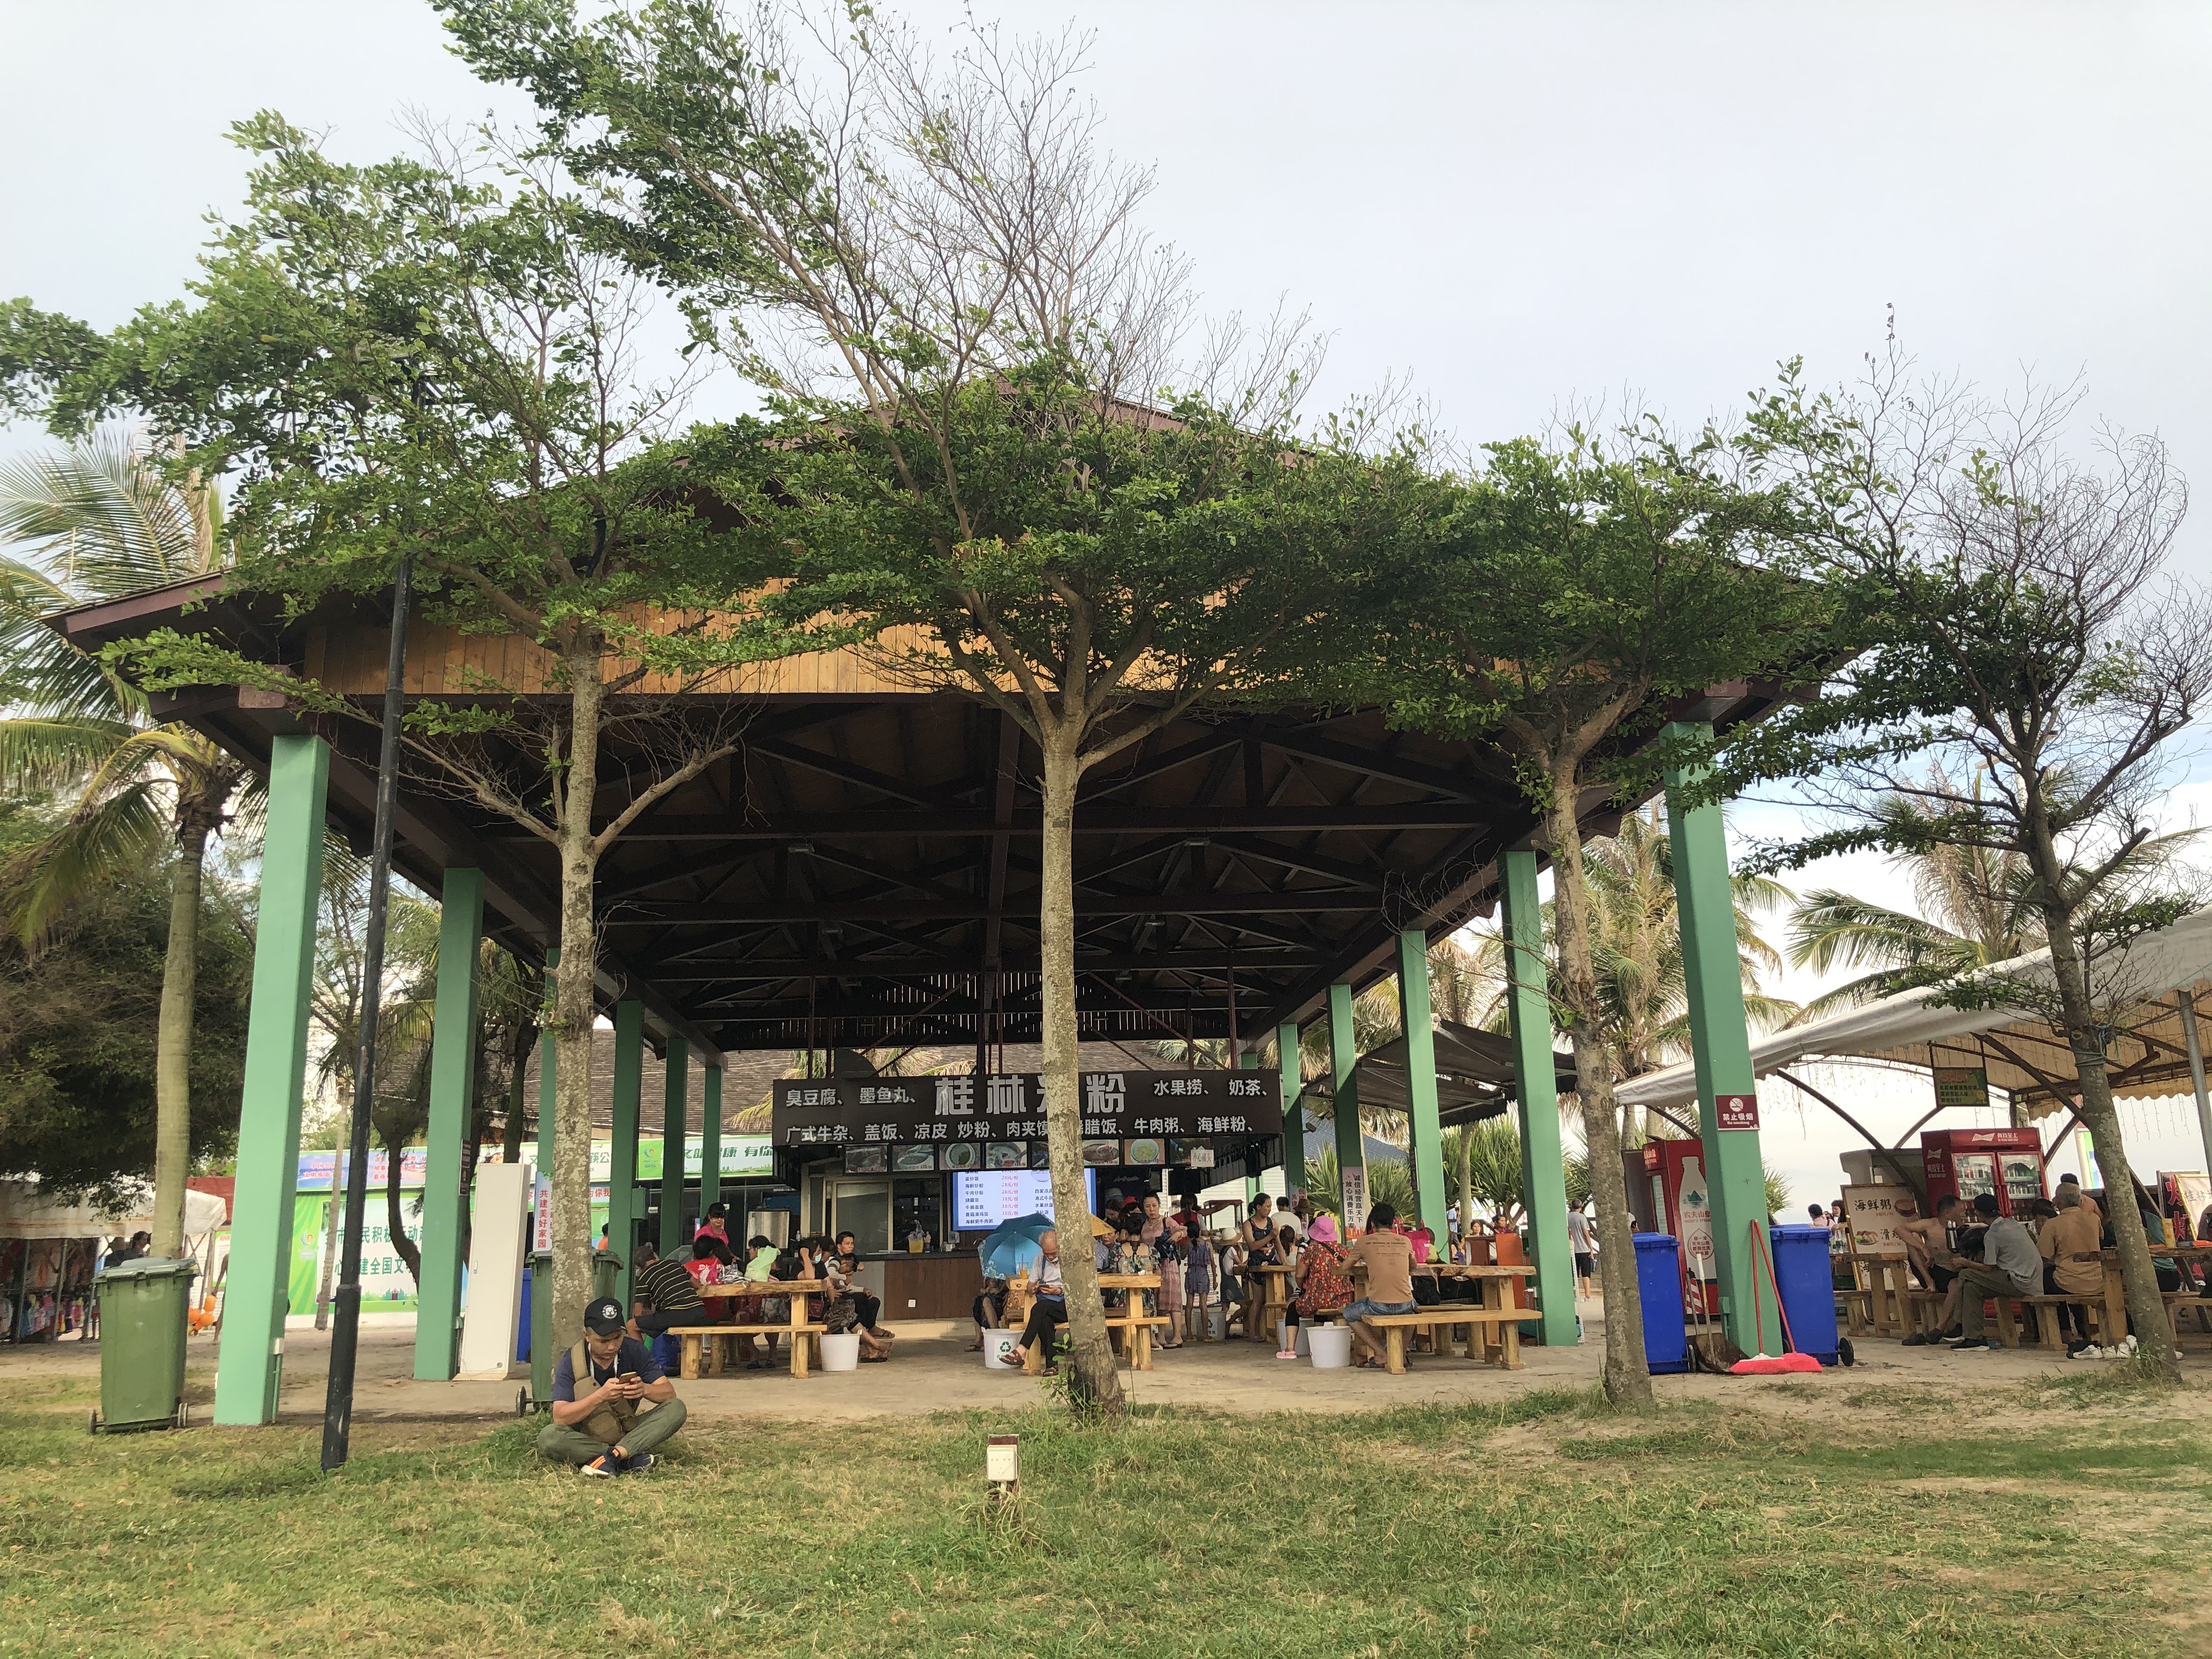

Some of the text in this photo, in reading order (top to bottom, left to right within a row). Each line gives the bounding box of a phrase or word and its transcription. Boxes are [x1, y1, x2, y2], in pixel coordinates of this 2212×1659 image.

[786, 1086, 916, 1107] 臭豆腐、 墨鱼丸、
[935, 1073, 1126, 1116] 桂林粉
[1153, 1079, 1268, 1097] 水果捞、 奶茶、
[1723, 1113, 1753, 1121] 禁止吸烟
[786, 1124, 854, 1143] 广式牛杂、
[864, 1123, 904, 1141] 盖饭、
[914, 1122, 947, 1139] 凉皮
[957, 1121, 998, 1138] 炒粉、
[1080, 1118, 1124, 1135] 腊饭、
[1134, 1117, 1185, 1134] 牛肉粥、
[1197, 1115, 1253, 1133] 海鲜粉、
[1854, 1198, 1892, 1211] 海鲜粥
[538, 1189, 549, 1248] 共建美好家园
[334, 1257, 413, 1276] 心建全国文
